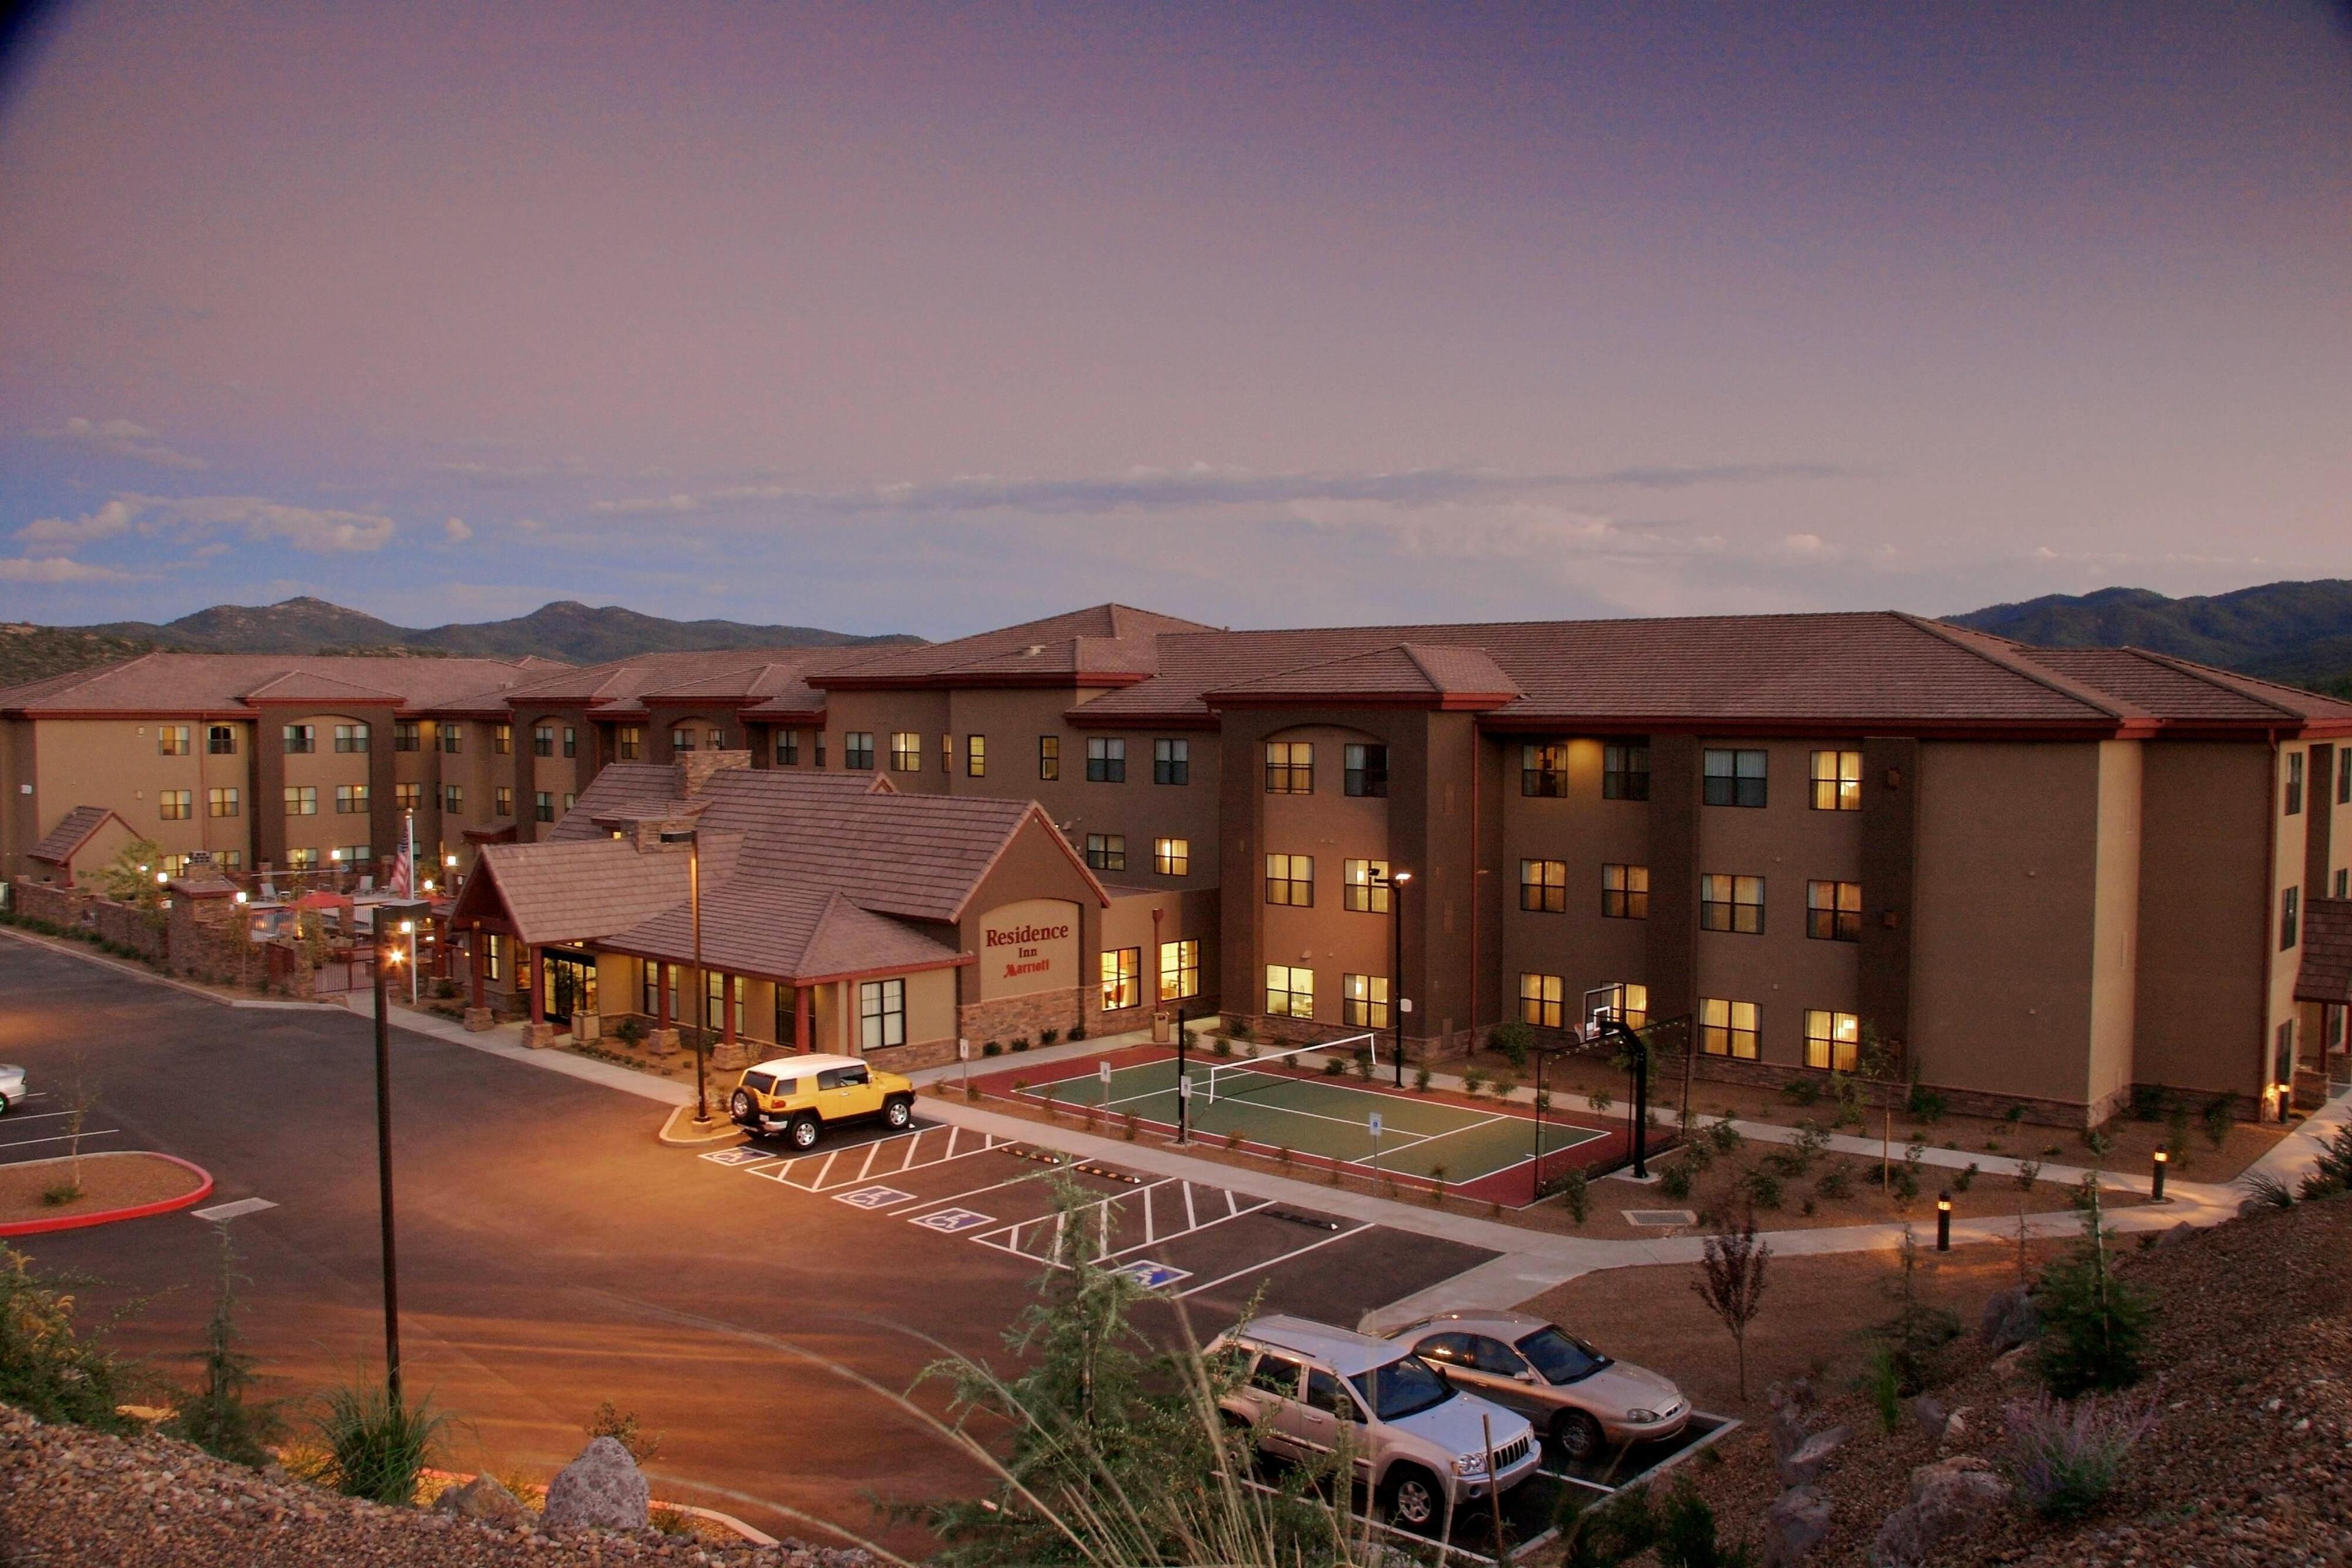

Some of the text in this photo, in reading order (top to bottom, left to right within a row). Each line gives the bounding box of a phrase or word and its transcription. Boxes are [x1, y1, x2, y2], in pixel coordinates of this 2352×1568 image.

[986, 925, 1068, 947] Residence
[1019, 948, 1038, 958] Inn
[1003, 959, 1049, 978] Marriott
